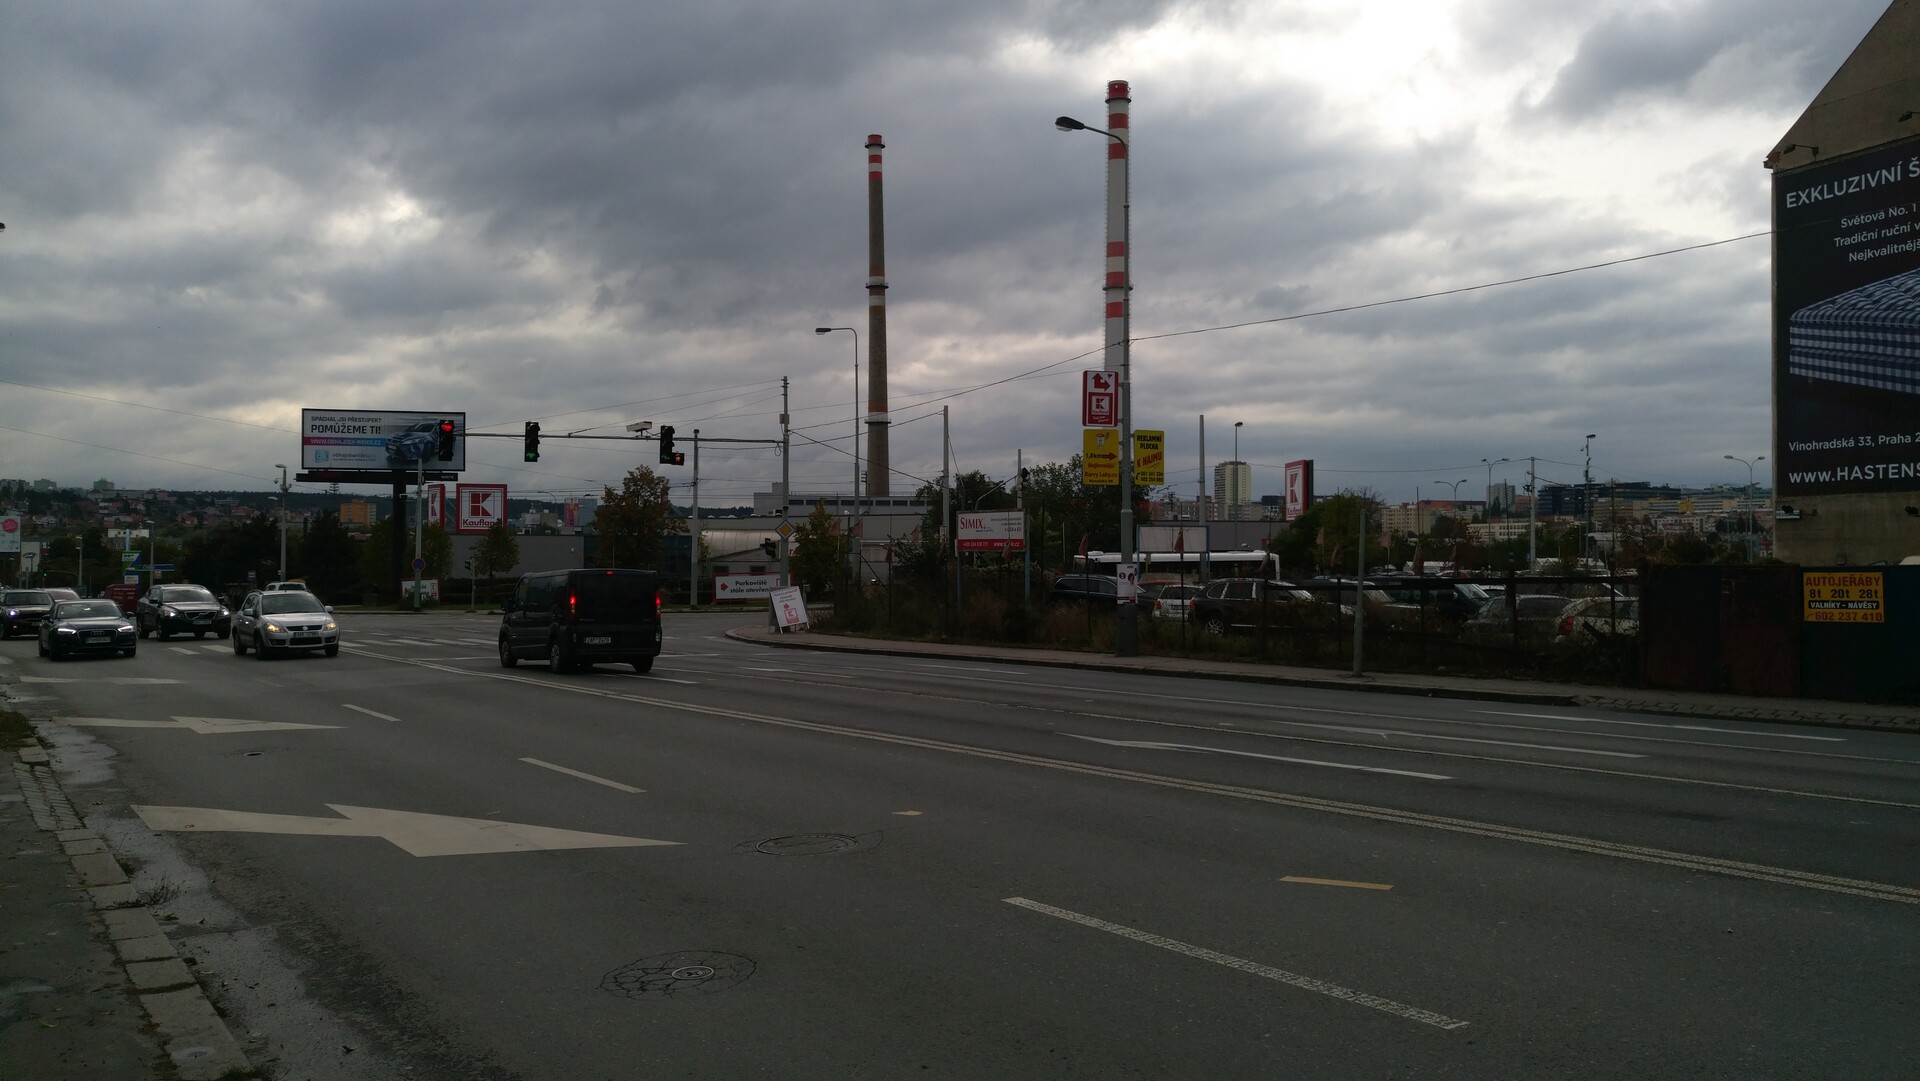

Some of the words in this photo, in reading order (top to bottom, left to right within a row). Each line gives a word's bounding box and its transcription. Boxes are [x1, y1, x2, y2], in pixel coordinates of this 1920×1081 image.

[1786, 161, 1902, 208] EXKLUZIVNÍ
[1841, 210, 1885, 228] Světová
[1888, 207, 1908, 218] No.
[1912, 203, 1916, 213] 1
[1834, 229, 1879, 247] Tradiční
[1881, 221, 1911, 238] ruční
[311, 422, 367, 434] POMŮŽEME
[369, 426, 381, 434] TI!
[1788, 437, 1855, 451] Vinohradská
[1858, 436, 1875, 447] 33,
[1878, 433, 1911, 445] Praha
[960, 517, 983, 529] SIMIX
[1806, 574, 1880, 587] AUTOJEŘÁBY
[1810, 601, 1841, 609] VALNÍKY
[1848, 601, 1877, 609] NÁVĚSY
[1815, 611, 1834, 620] 602
[1838, 612, 1857, 621] 237
[1862, 612, 1882, 621] 410
